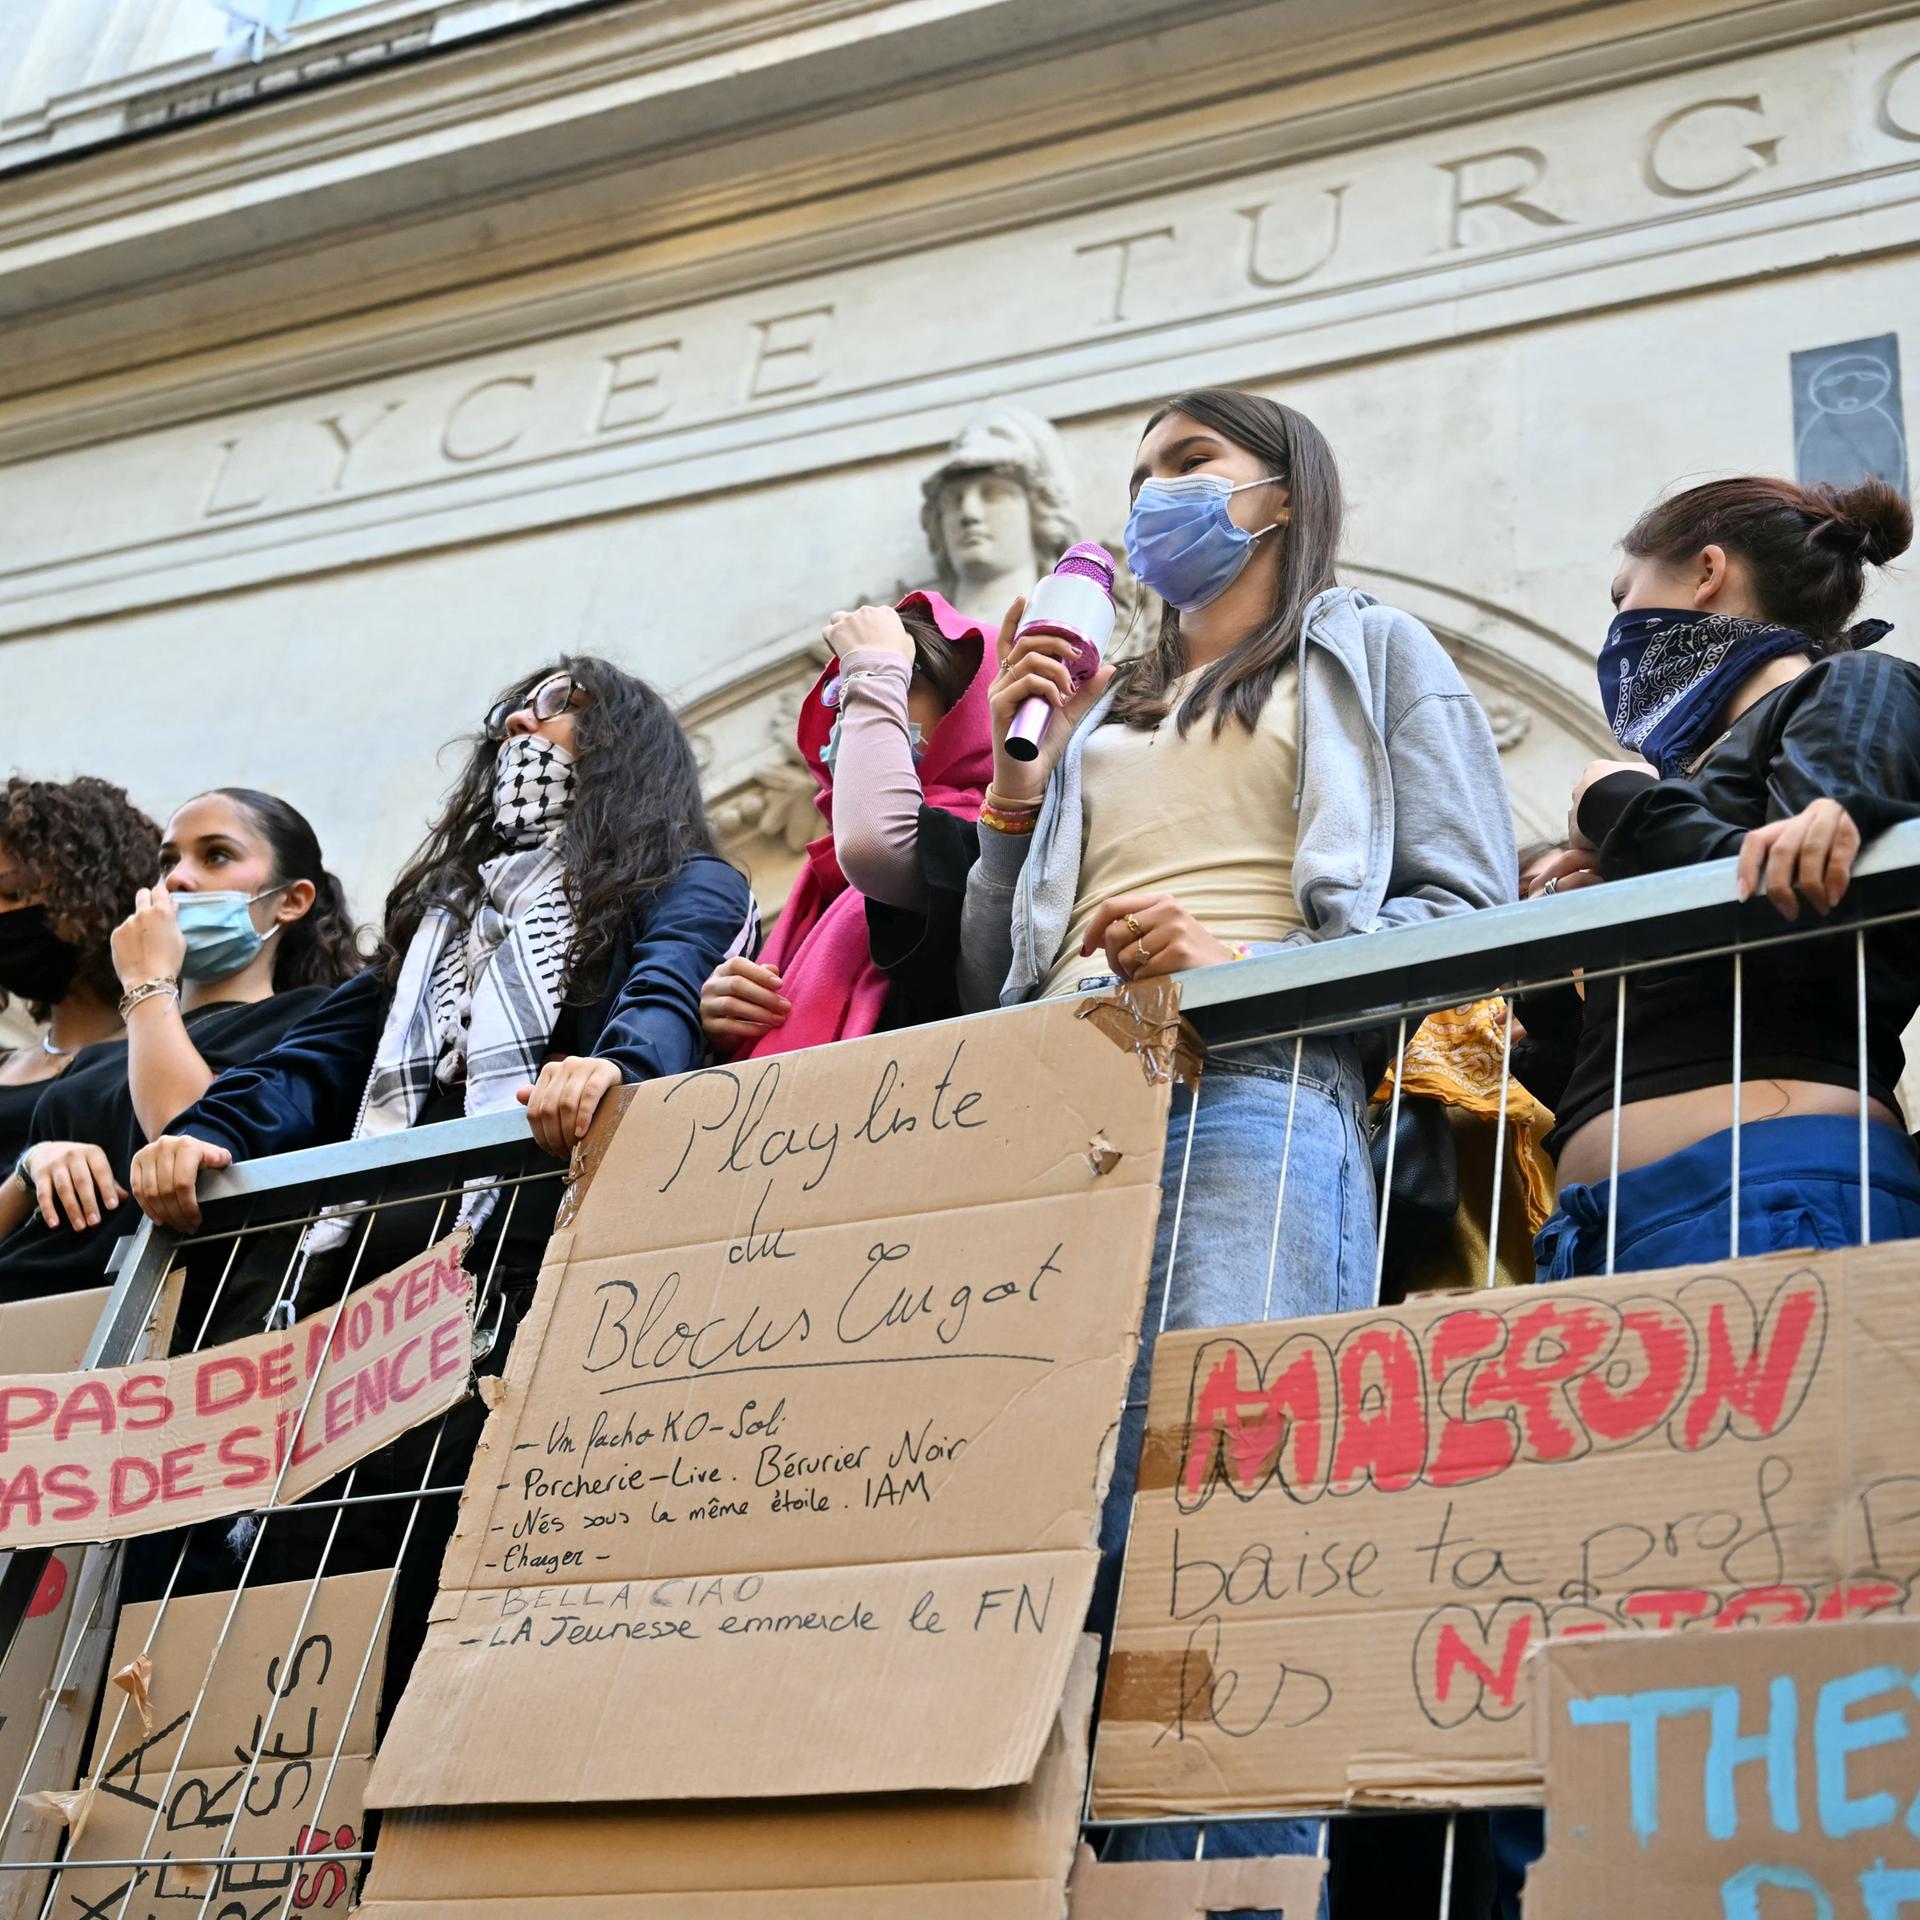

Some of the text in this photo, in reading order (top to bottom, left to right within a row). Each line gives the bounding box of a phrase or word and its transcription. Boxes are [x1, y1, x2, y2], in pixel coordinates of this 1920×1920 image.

[200, 302, 836, 519] LYCEE
[728, 1178, 799, 1264] du
[581, 1271, 810, 1373] Blocus
[0, 1373, 175, 1455] PAS
[195, 1342, 298, 1418] DE
[546, 1415, 577, 1456] Un
[0, 1462, 100, 1535] AS
[108, 1442, 206, 1518] DE
[755, 1444, 871, 1488] Bérurier
[889, 1418, 968, 1468] Noir
[511, 1506, 565, 1539] Nés
[583, 1512, 630, 1530] sous
[650, 1500, 677, 1523] la
[689, 1496, 749, 1521] même
[865, 1471, 931, 1509] IAM
[1170, 1528, 1384, 1620] baise
[1415, 1502, 1545, 1590] ta
[1559, 1453, 1803, 1608] prof
[488, 1616, 533, 1648] LA
[540, 1614, 702, 1648] Jeunesse
[908, 1590, 948, 1634] le
[973, 1577, 1055, 1635] FN
[500, 1573, 765, 1618] BELLA CIAO
[1152, 1613, 1333, 1749] les
[1568, 1665, 1920, 1853] THE
